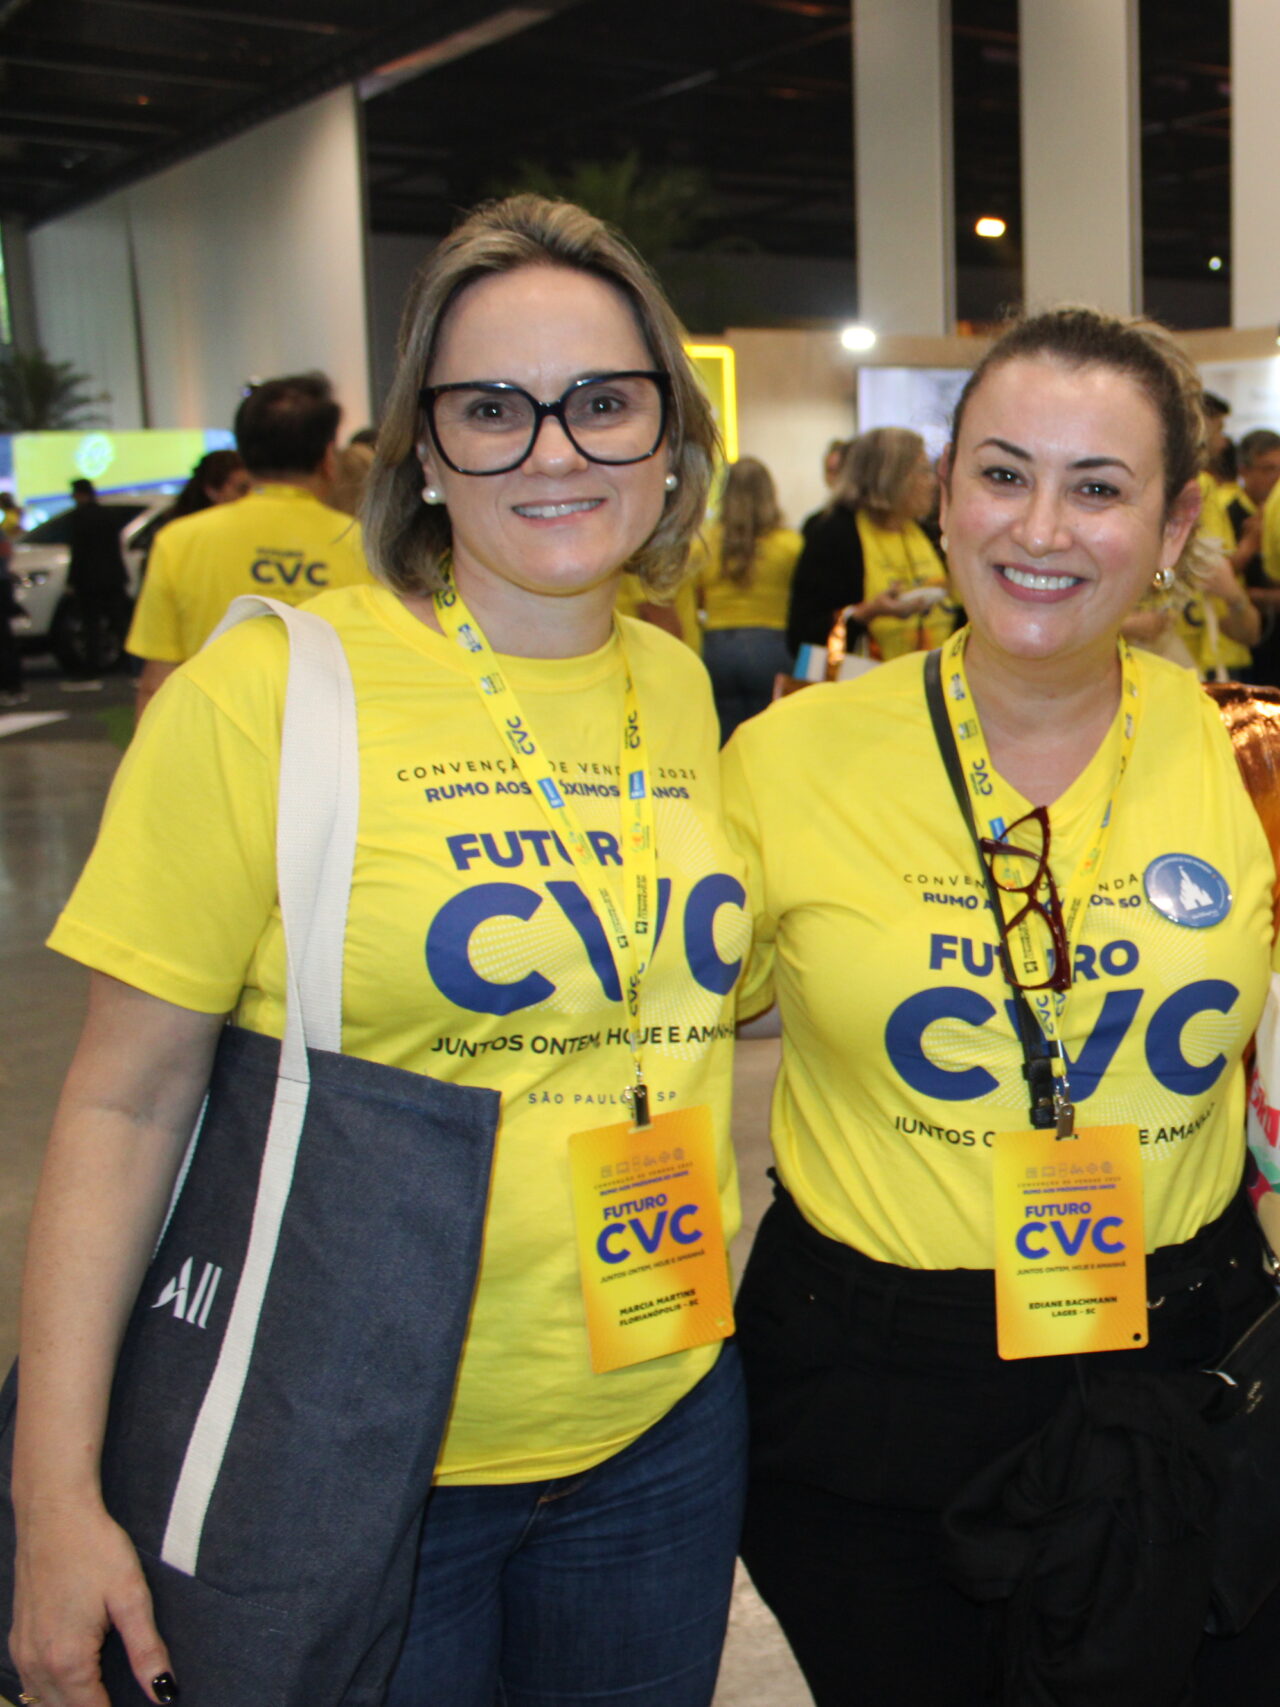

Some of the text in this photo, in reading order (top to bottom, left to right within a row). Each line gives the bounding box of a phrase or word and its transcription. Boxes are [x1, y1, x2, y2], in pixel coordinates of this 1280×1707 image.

[251, 559, 330, 587] CVC
[506, 715, 536, 756] CVC
[973, 758, 993, 796] CVC
[425, 781, 490, 803] RUMO
[495, 781, 532, 796] AOS
[923, 891, 979, 910] RUMO
[425, 872, 748, 1017] CVC
[431, 1034, 523, 1058] JUNTOS
[668, 1026, 680, 1043] E
[885, 978, 1241, 1103] CVC
[528, 1091, 565, 1105] SÃO
[656, 1091, 678, 1102] SP
[1138, 1129, 1150, 1146] E
[603, 1193, 669, 1221] FUTURO
[1025, 1201, 1093, 1219] FUTURO
[596, 1203, 704, 1265] CVC
[1015, 1215, 1127, 1260] CVC
[619, 1288, 696, 1316] MARCIA MARTINS
[1029, 1300, 1063, 1310] EDIANE
[1051, 1309, 1078, 1318] LAGES
